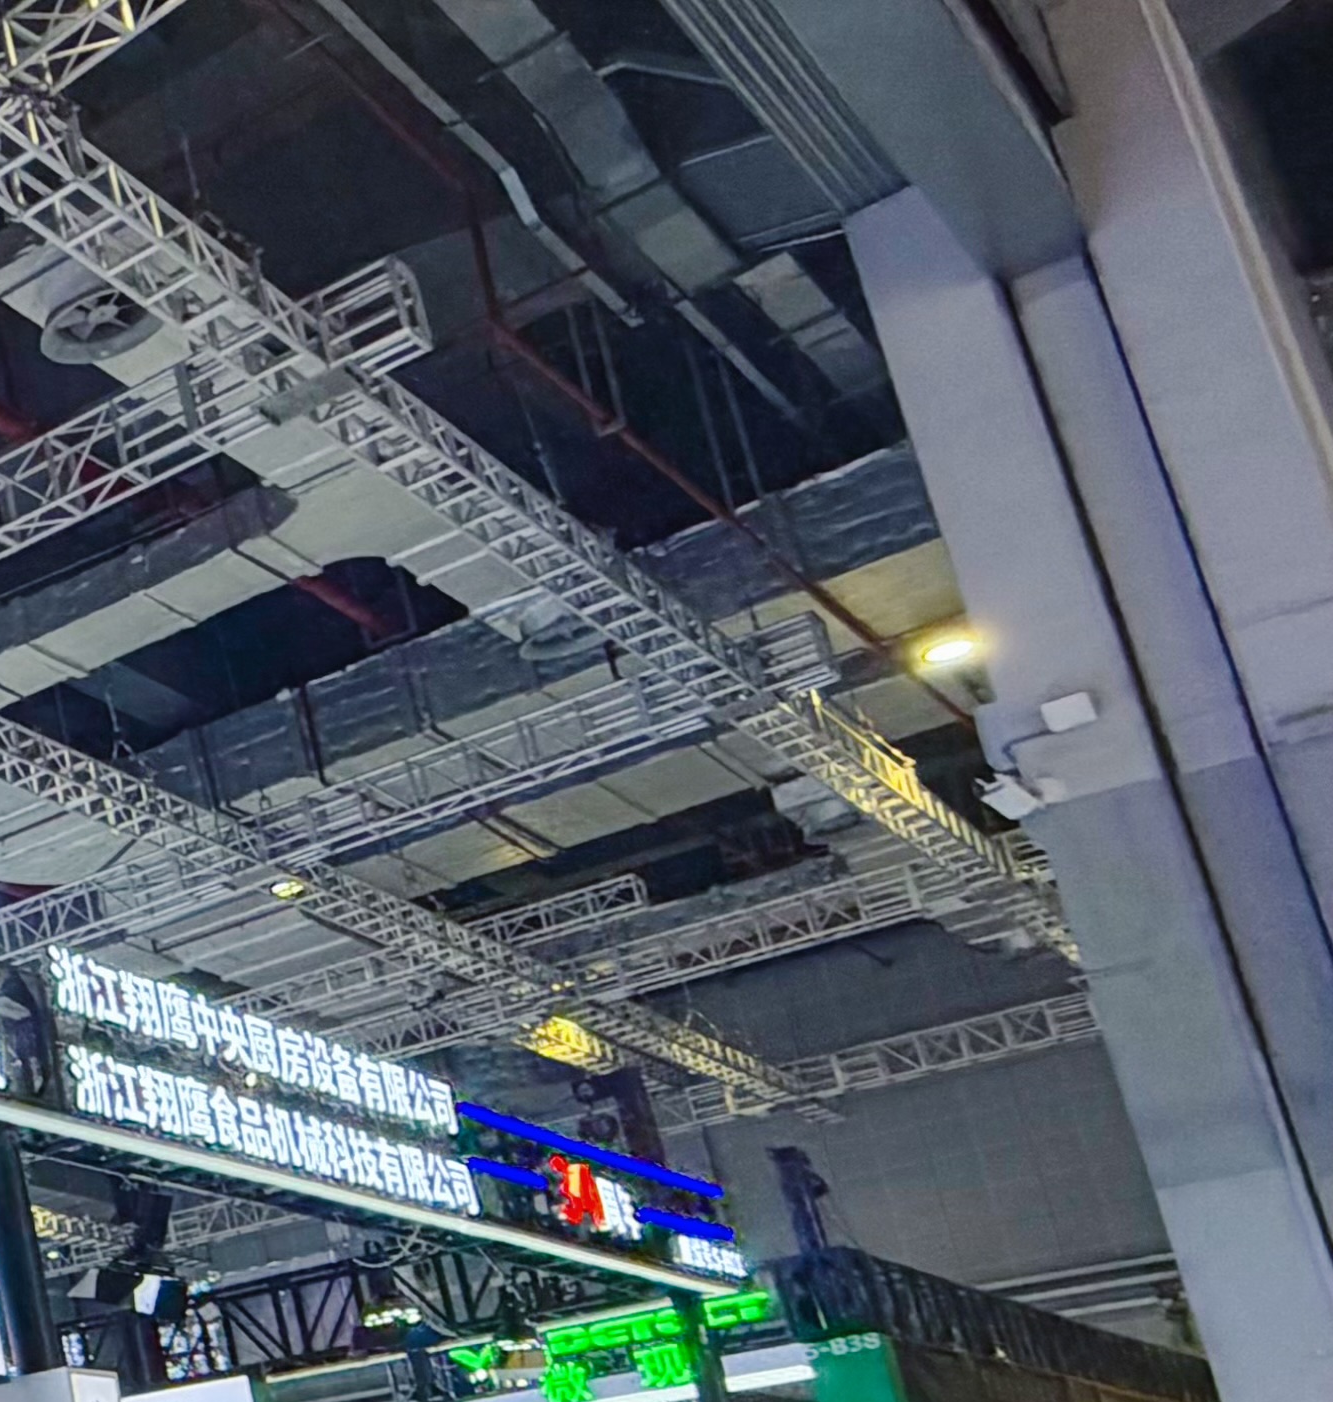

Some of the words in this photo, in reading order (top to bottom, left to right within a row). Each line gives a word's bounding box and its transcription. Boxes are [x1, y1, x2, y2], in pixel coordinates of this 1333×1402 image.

[47, 944, 460, 1136] 浙江翔鹰中央厨房设备有限公司
[67, 1043, 481, 1217] 浙江翔鹰食品机械科技有限公司
